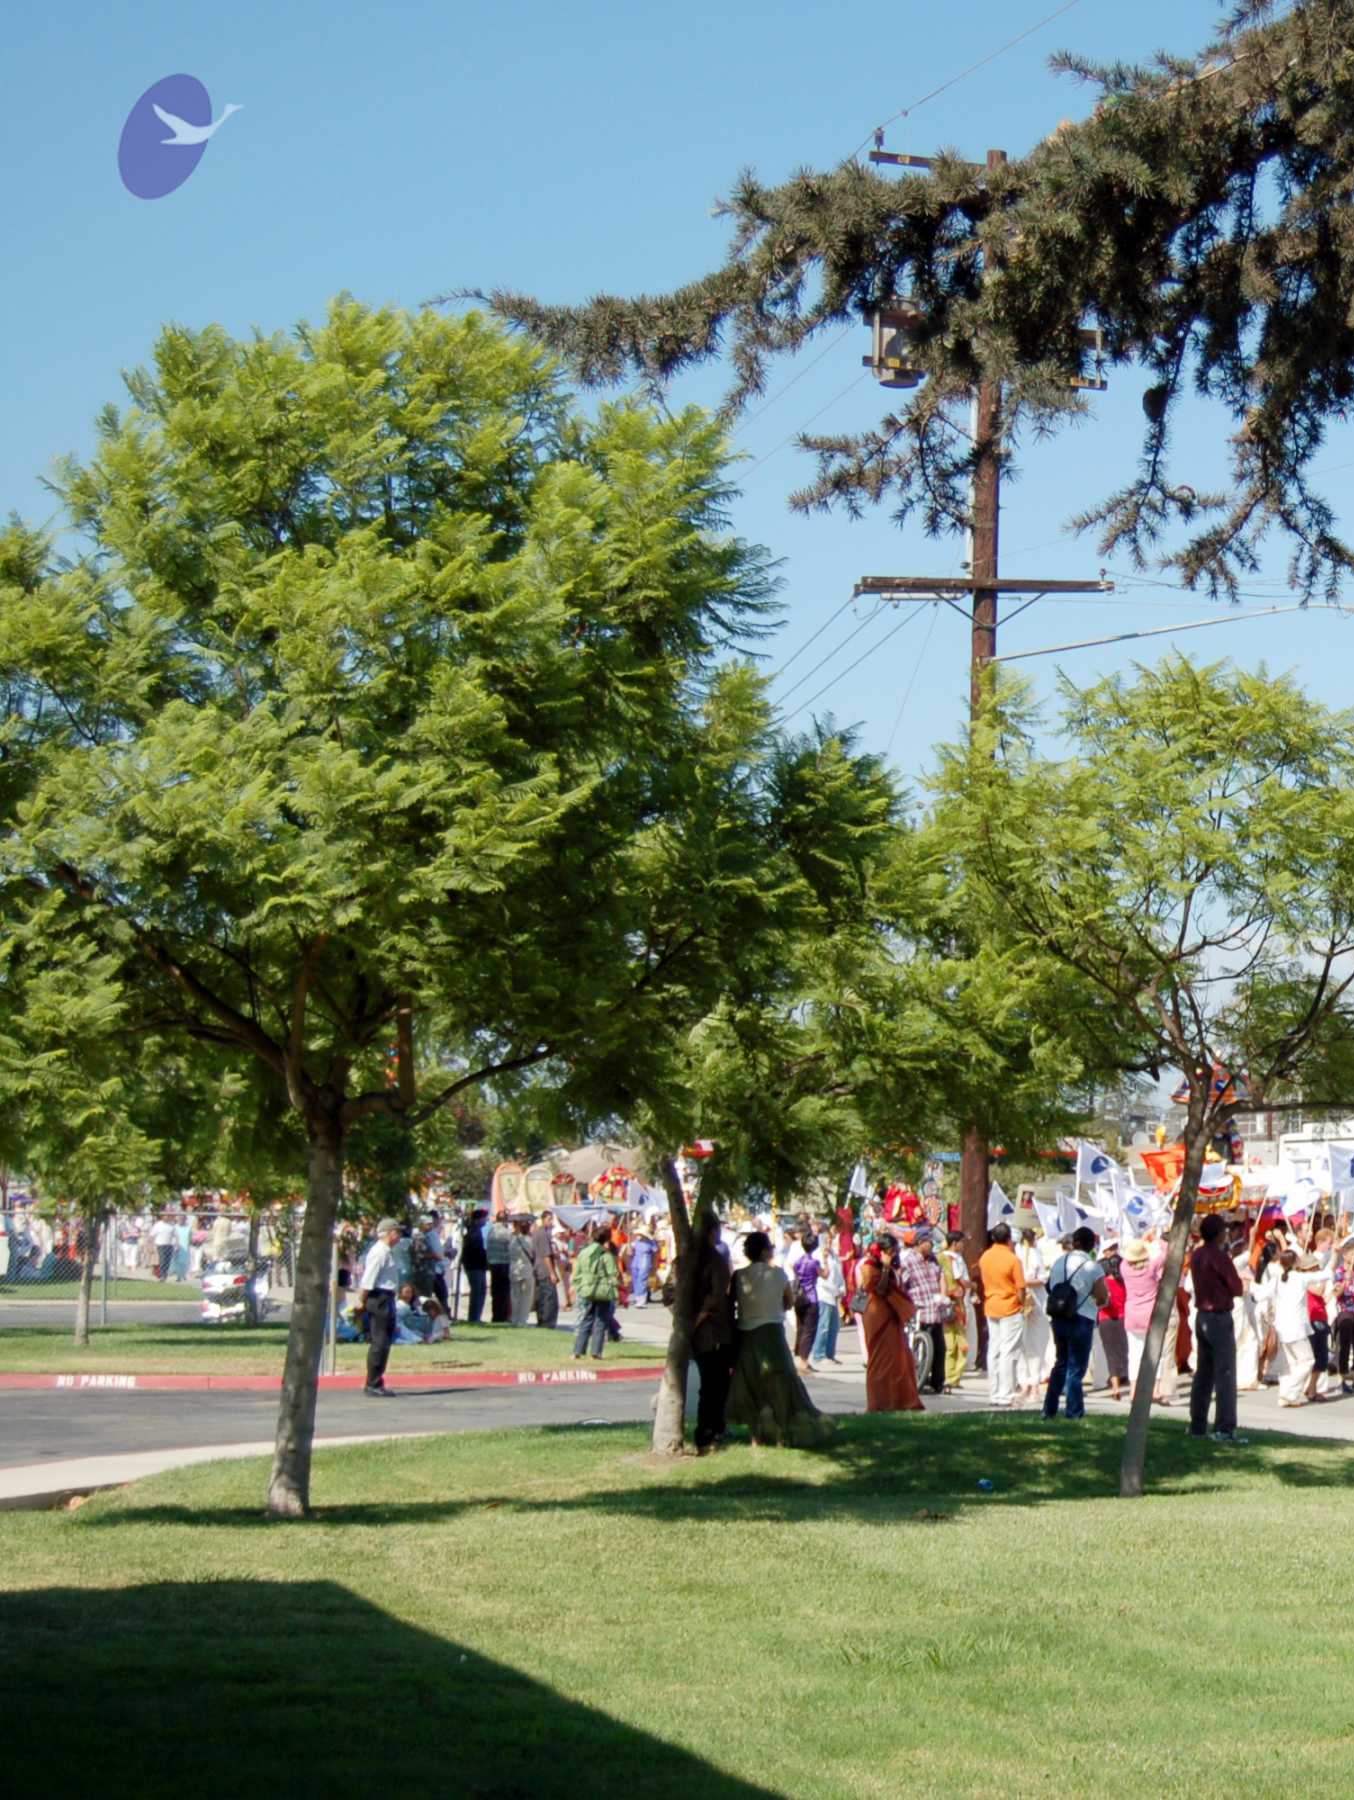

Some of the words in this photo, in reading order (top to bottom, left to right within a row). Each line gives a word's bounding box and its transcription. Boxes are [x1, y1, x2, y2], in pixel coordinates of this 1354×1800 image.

[56, 1375, 74, 1388] NO
[80, 1375, 137, 1388] PARKING
[518, 1371, 536, 1384] NO
[542, 1370, 597, 1383] PARKING
